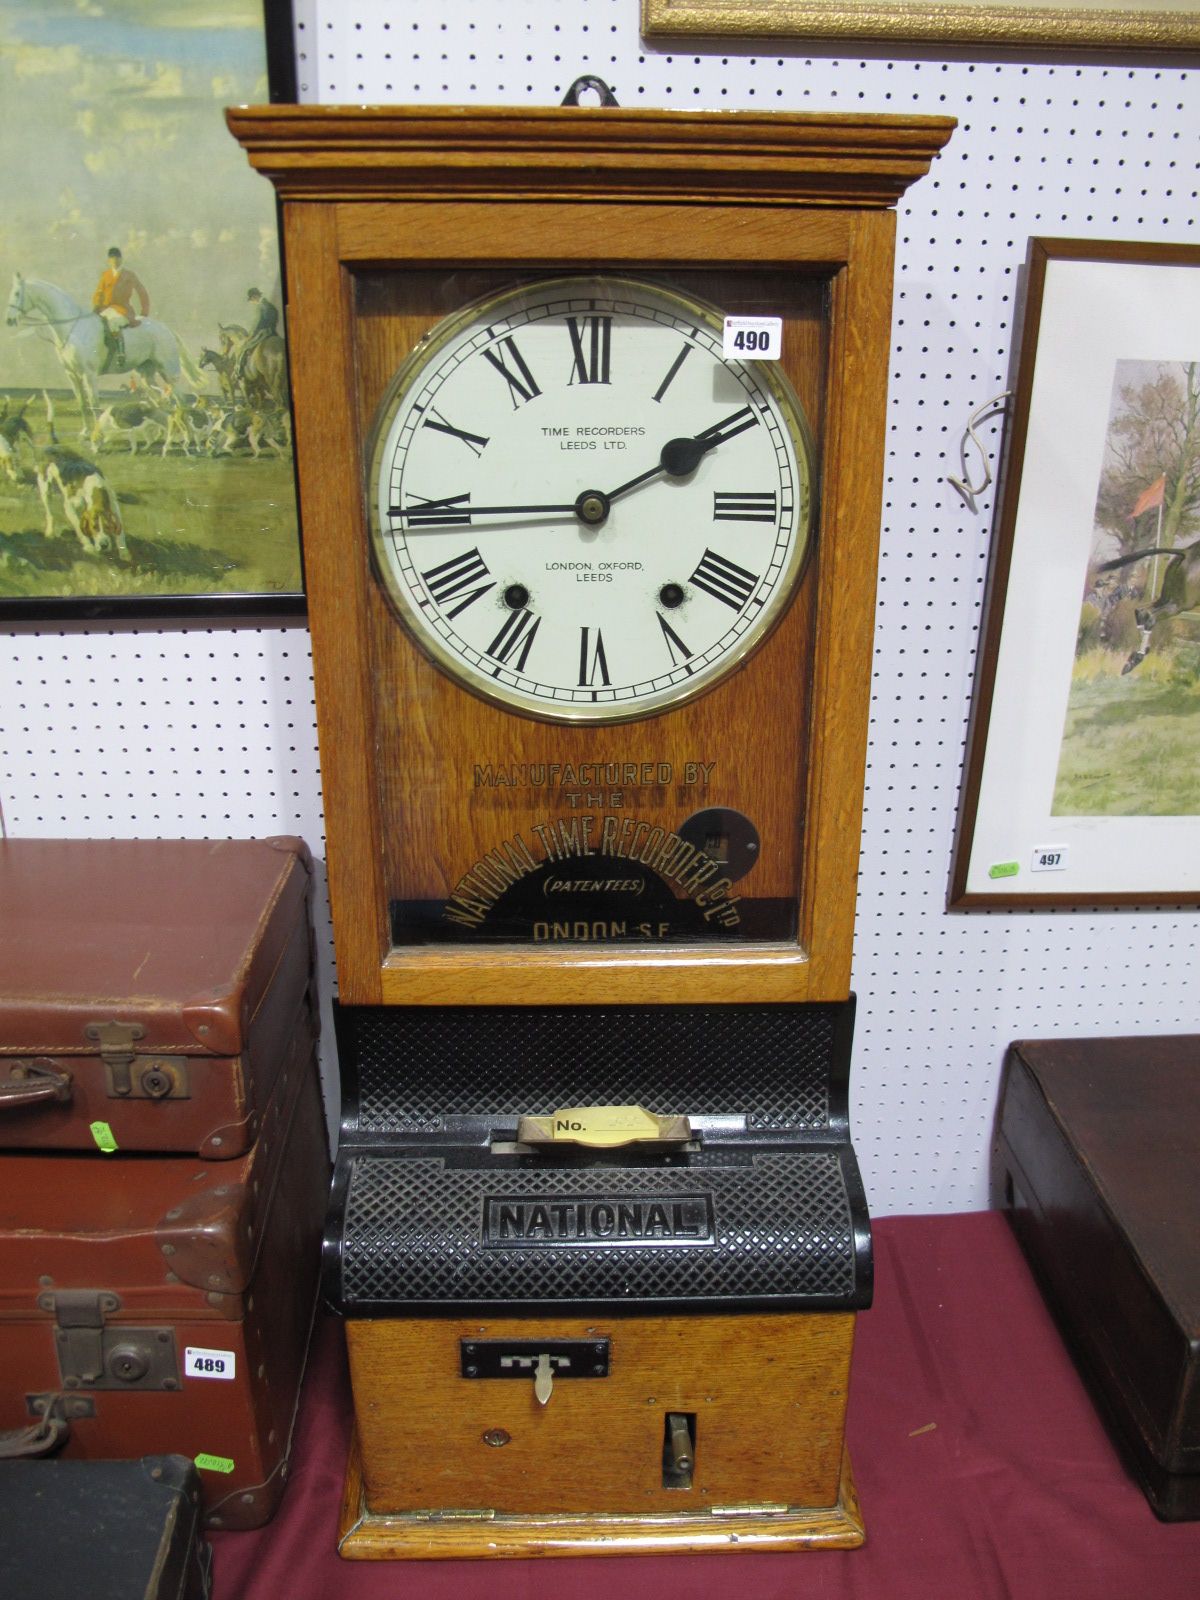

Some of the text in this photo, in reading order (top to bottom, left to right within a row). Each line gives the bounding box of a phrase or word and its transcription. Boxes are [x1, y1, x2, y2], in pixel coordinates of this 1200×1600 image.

[565, 316, 612, 386] XII
[733, 330, 770, 351] 490
[480, 334, 543, 411] XI
[651, 341, 695, 404] I
[422, 405, 491, 459] X
[540, 426, 647, 437] TIME RECORDERS
[560, 440, 628, 451] LEEDS LTD.
[713, 490, 777, 525] III
[575, 573, 614, 583] LEEDS
[577, 626, 612, 687] VI
[473, 761, 716, 787] MANUFACTURED BY
[566, 792, 624, 808] THE
[441, 833, 544, 929] NATIONAL
[531, 815, 595, 864] TIME
[602, 815, 719, 895] RECORDER
[1039, 853, 1062, 866] 497
[556, 1119, 587, 1131] No.
[500, 1203, 699, 1238] NATIONAL
[194, 1357, 226, 1373] 489
